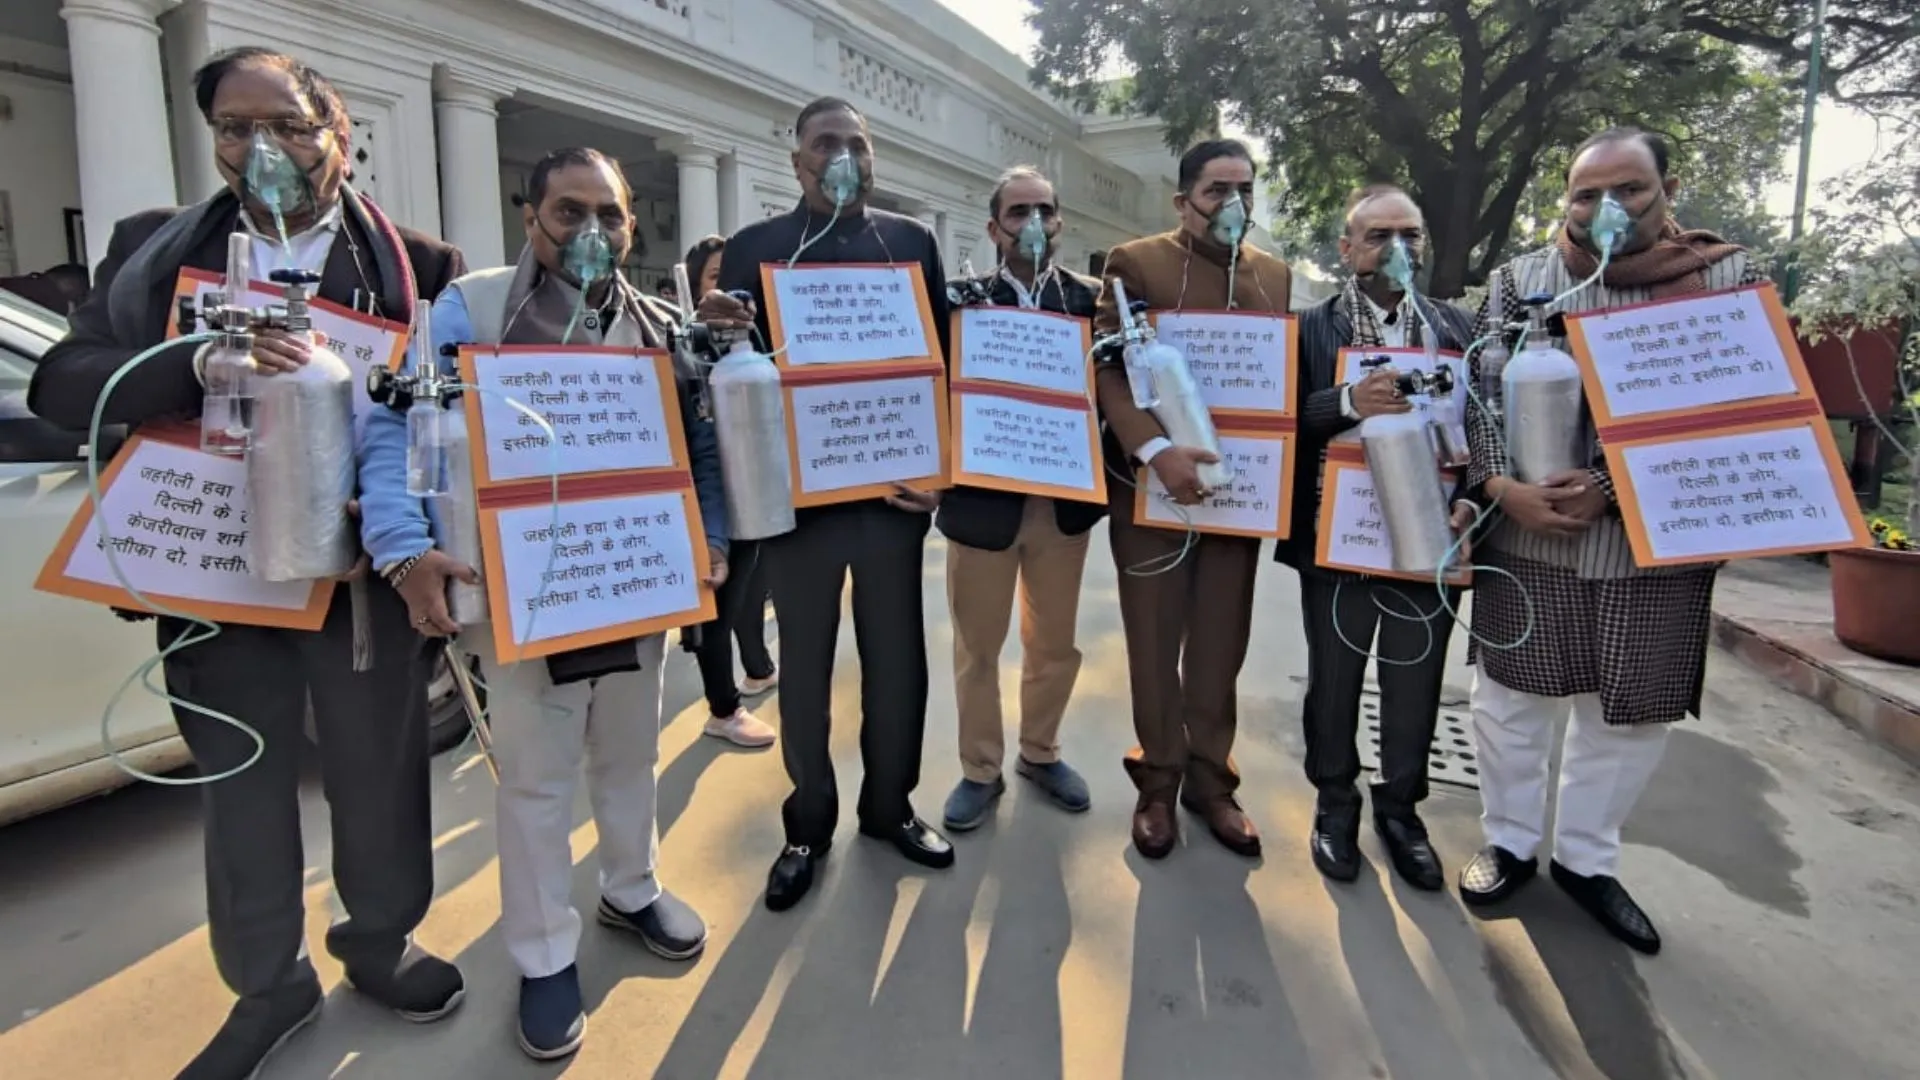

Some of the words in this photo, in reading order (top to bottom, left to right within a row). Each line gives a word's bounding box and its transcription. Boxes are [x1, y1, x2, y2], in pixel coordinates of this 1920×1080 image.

[354, 345, 374, 362] रहे
[141, 467, 195, 490] जहरीली
[202, 480, 235, 498] हवा
[154, 490, 203, 515] दिल्ली
[213, 503, 232, 520] के
[128, 511, 207, 541] केजरीवाल
[216, 531, 249, 547] शर्म
